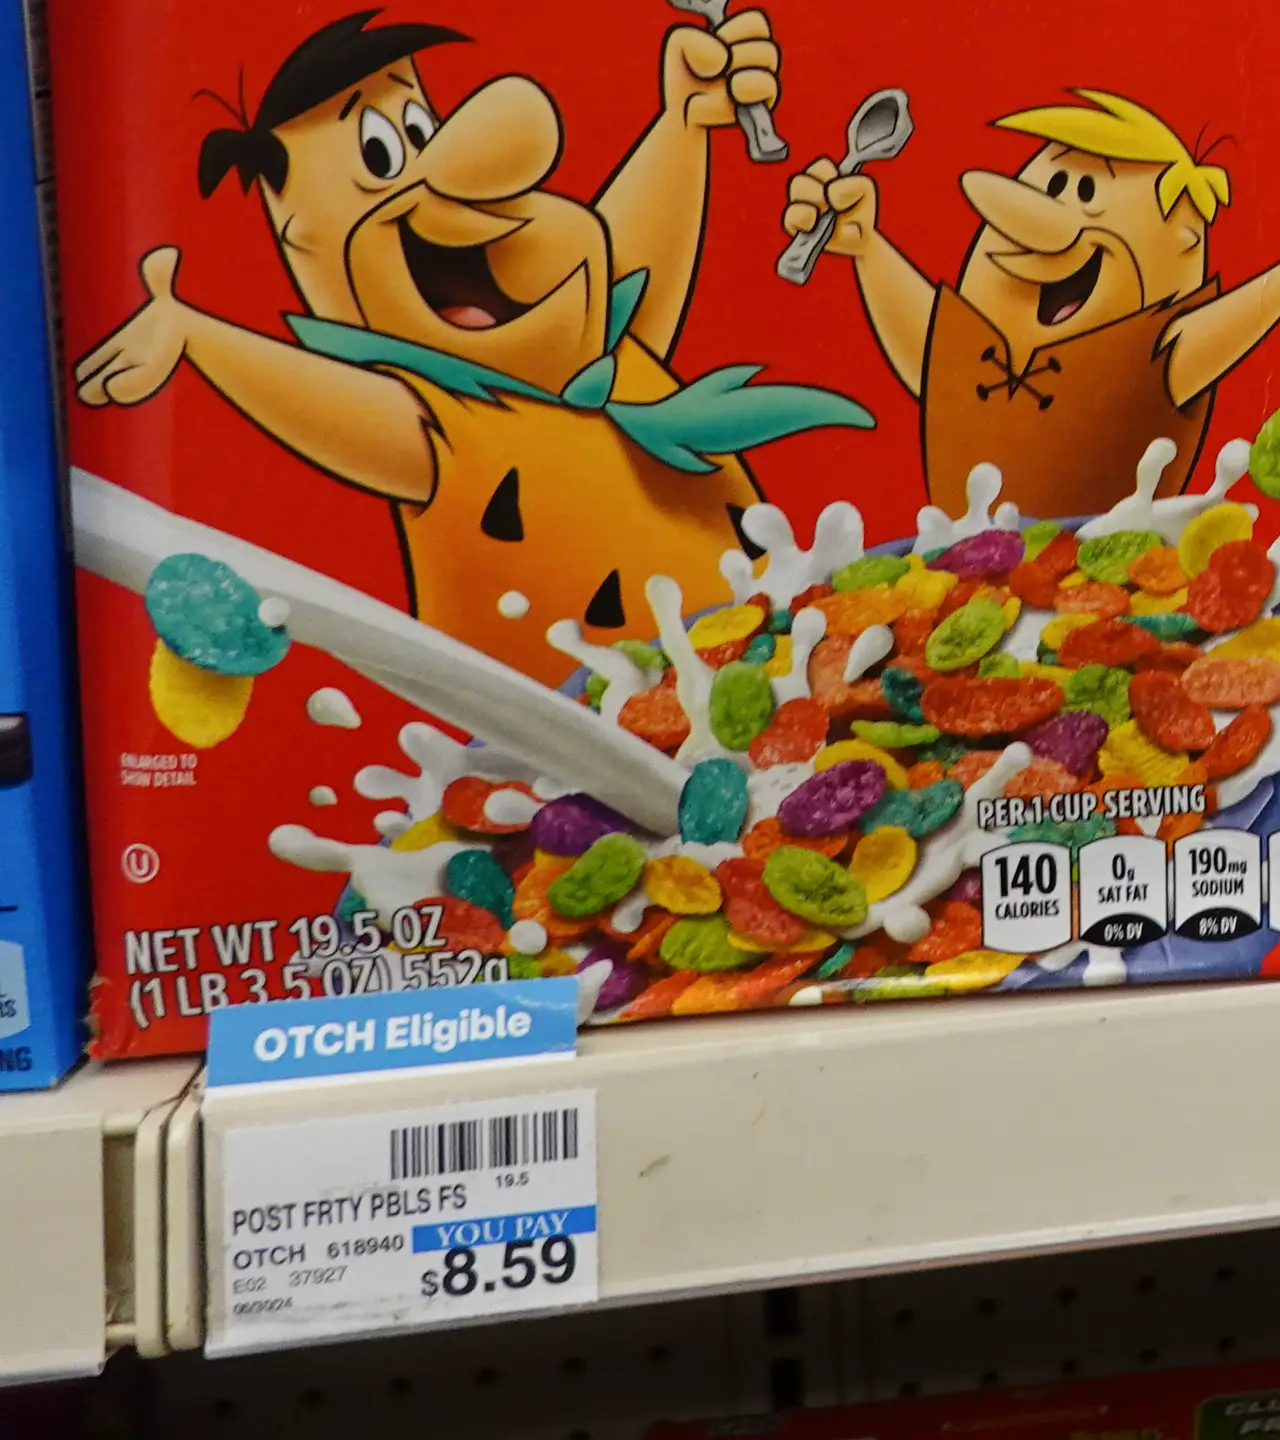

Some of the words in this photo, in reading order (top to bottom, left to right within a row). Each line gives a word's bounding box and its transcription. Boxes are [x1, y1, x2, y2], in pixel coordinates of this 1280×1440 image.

[977, 796, 1026, 831] PER
[1032, 795, 1043, 823] 1
[1046, 789, 1095, 822] CUP
[1104, 785, 1206, 818] SERVING
[995, 853, 1058, 897] 140
[1192, 879, 1244, 897] SODIUM
[995, 898, 1059, 921] CALORIES
[125, 926, 200, 976] NET
[210, 921, 278, 968] WT
[288, 912, 381, 960] 19.5
[392, 904, 447, 950] OZ
[129, 976, 166, 1029] (1
[254, 1019, 376, 1062] OTCH
[386, 1005, 531, 1052] Eligible
[495, 1172, 529, 1189] 19.5
[232, 1204, 297, 1236] POST
[304, 1196, 363, 1228] FRTY
[370, 1189, 430, 1219] PBLS
[439, 1185, 467, 1211] FS
[437, 1220, 505, 1248] YOU
[514, 1210, 570, 1236] PAY
[233, 1244, 305, 1270] OTCH
[327, 1235, 404, 1259] 618940
[420, 1235, 576, 1299] $8.59
